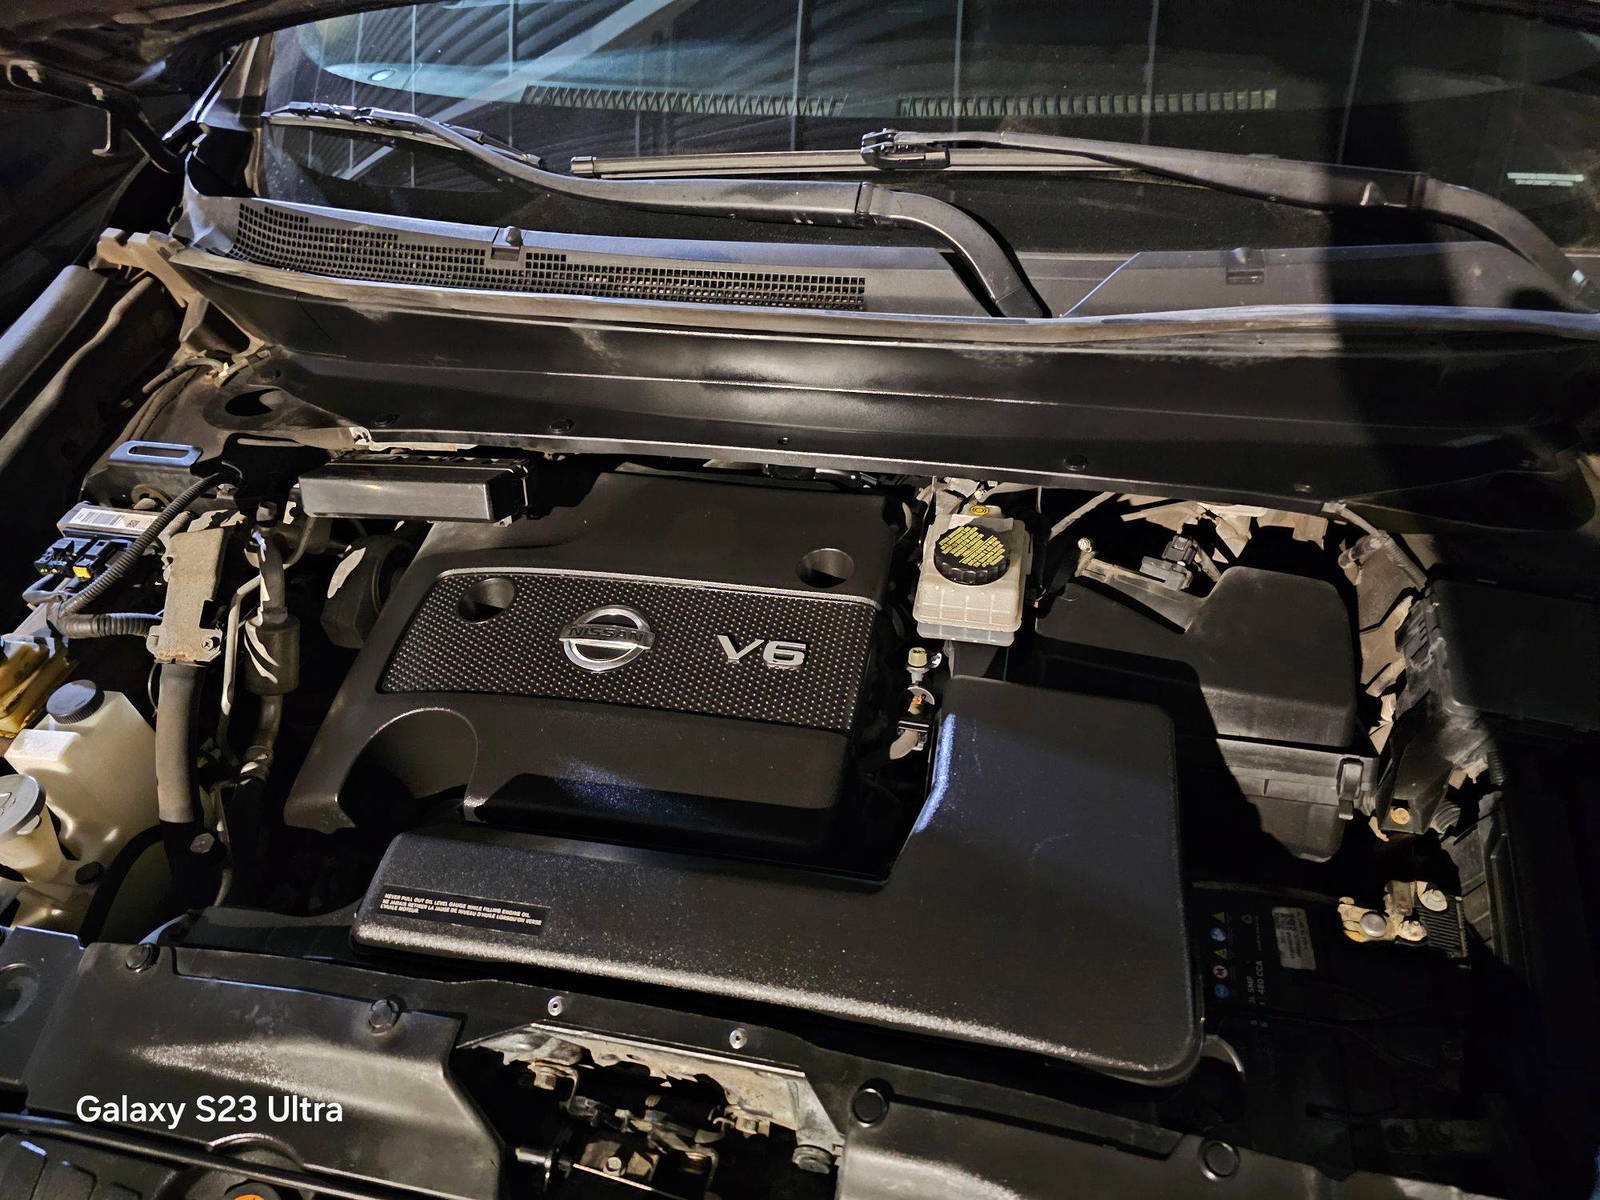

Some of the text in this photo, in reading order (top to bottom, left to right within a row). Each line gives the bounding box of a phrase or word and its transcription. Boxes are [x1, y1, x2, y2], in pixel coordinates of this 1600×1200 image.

[568, 627, 644, 642] NISSAN
[717, 634, 807, 669] V6
[448, 901, 467, 909] GAUGE
